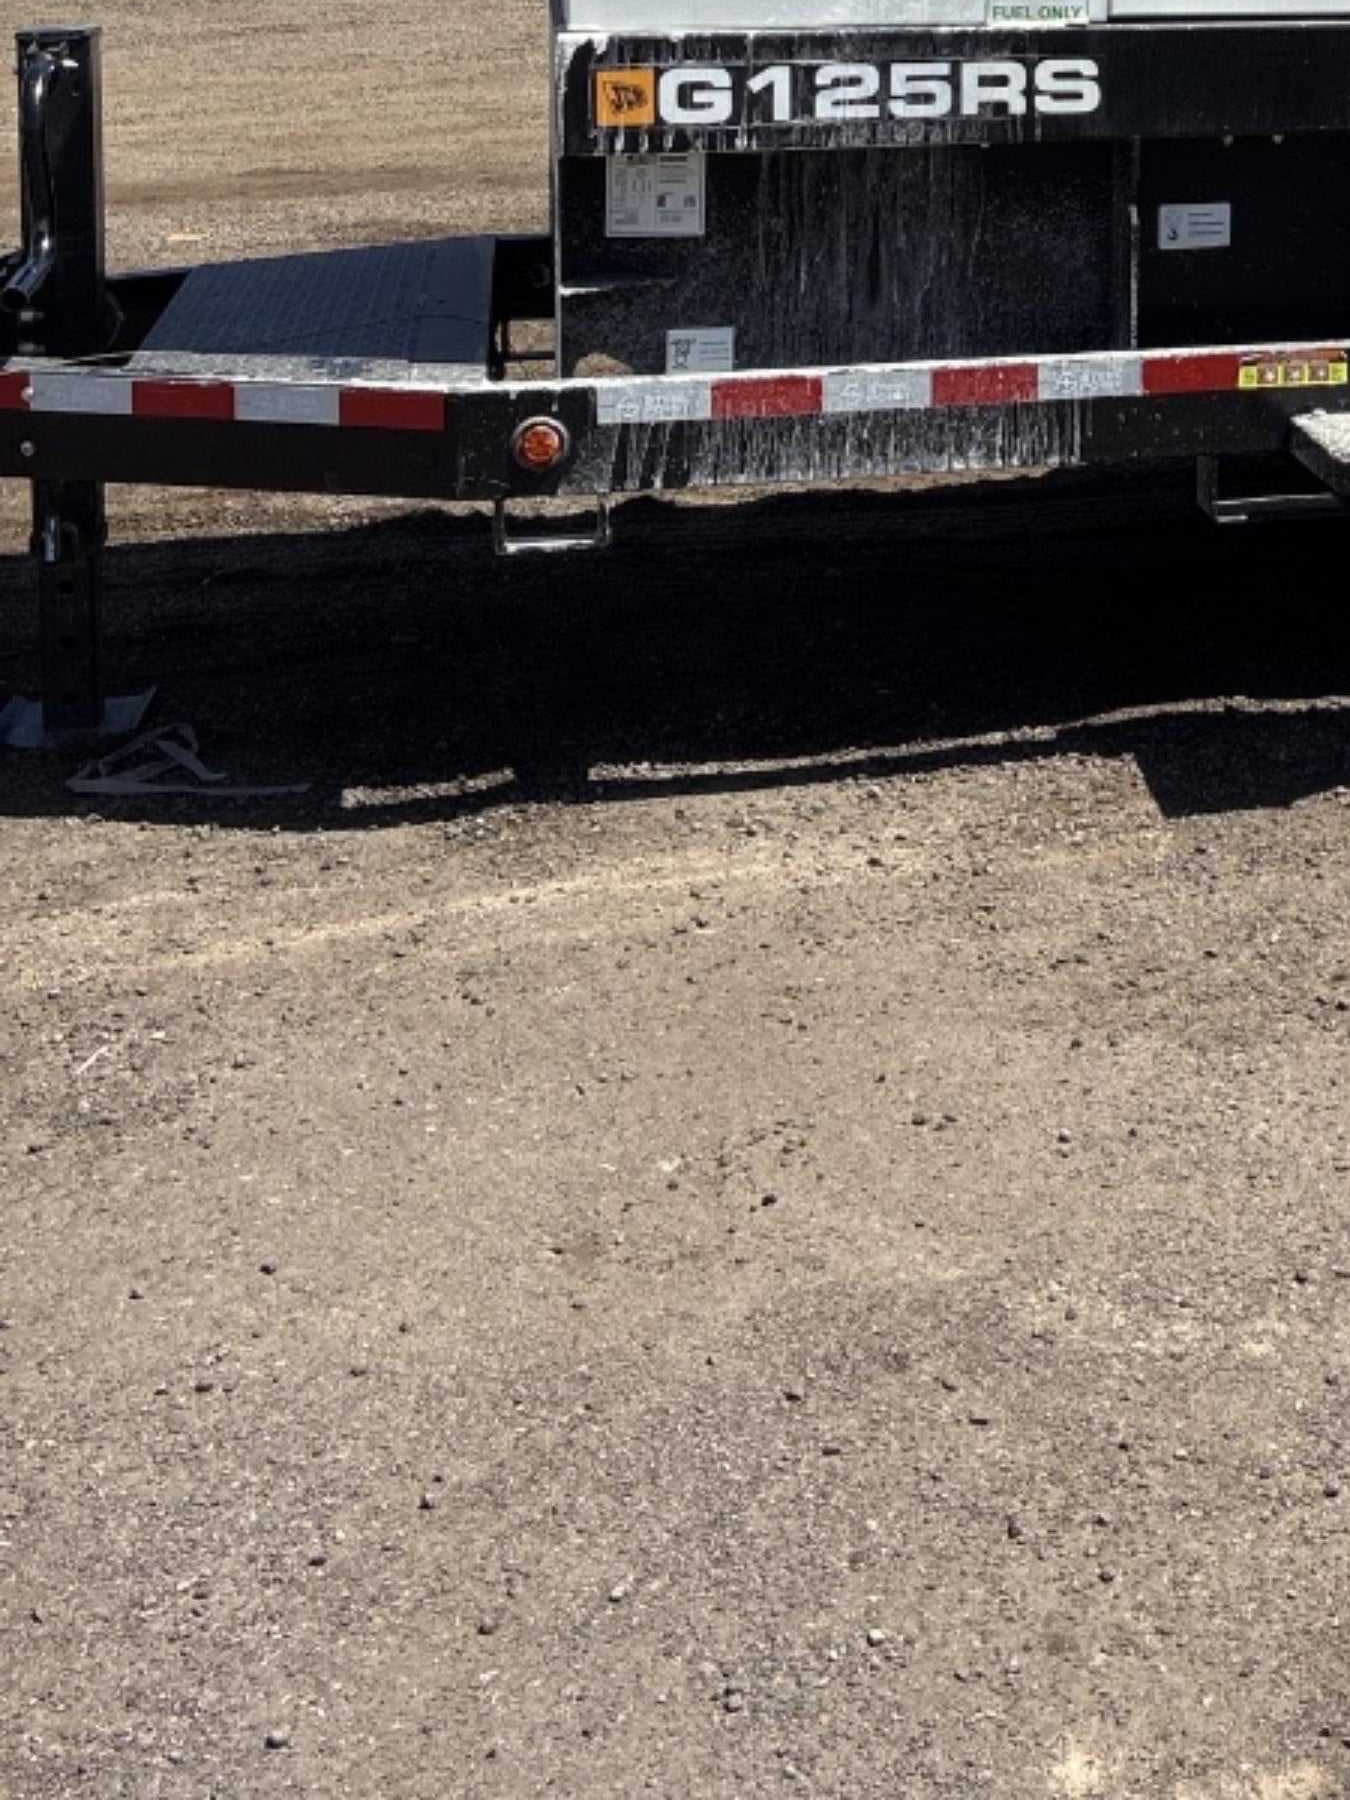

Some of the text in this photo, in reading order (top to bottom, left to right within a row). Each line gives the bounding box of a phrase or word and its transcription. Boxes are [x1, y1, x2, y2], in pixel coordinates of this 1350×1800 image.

[992, 5, 1083, 20] FUEL ONLY
[658, 58, 1101, 125] G125RS
